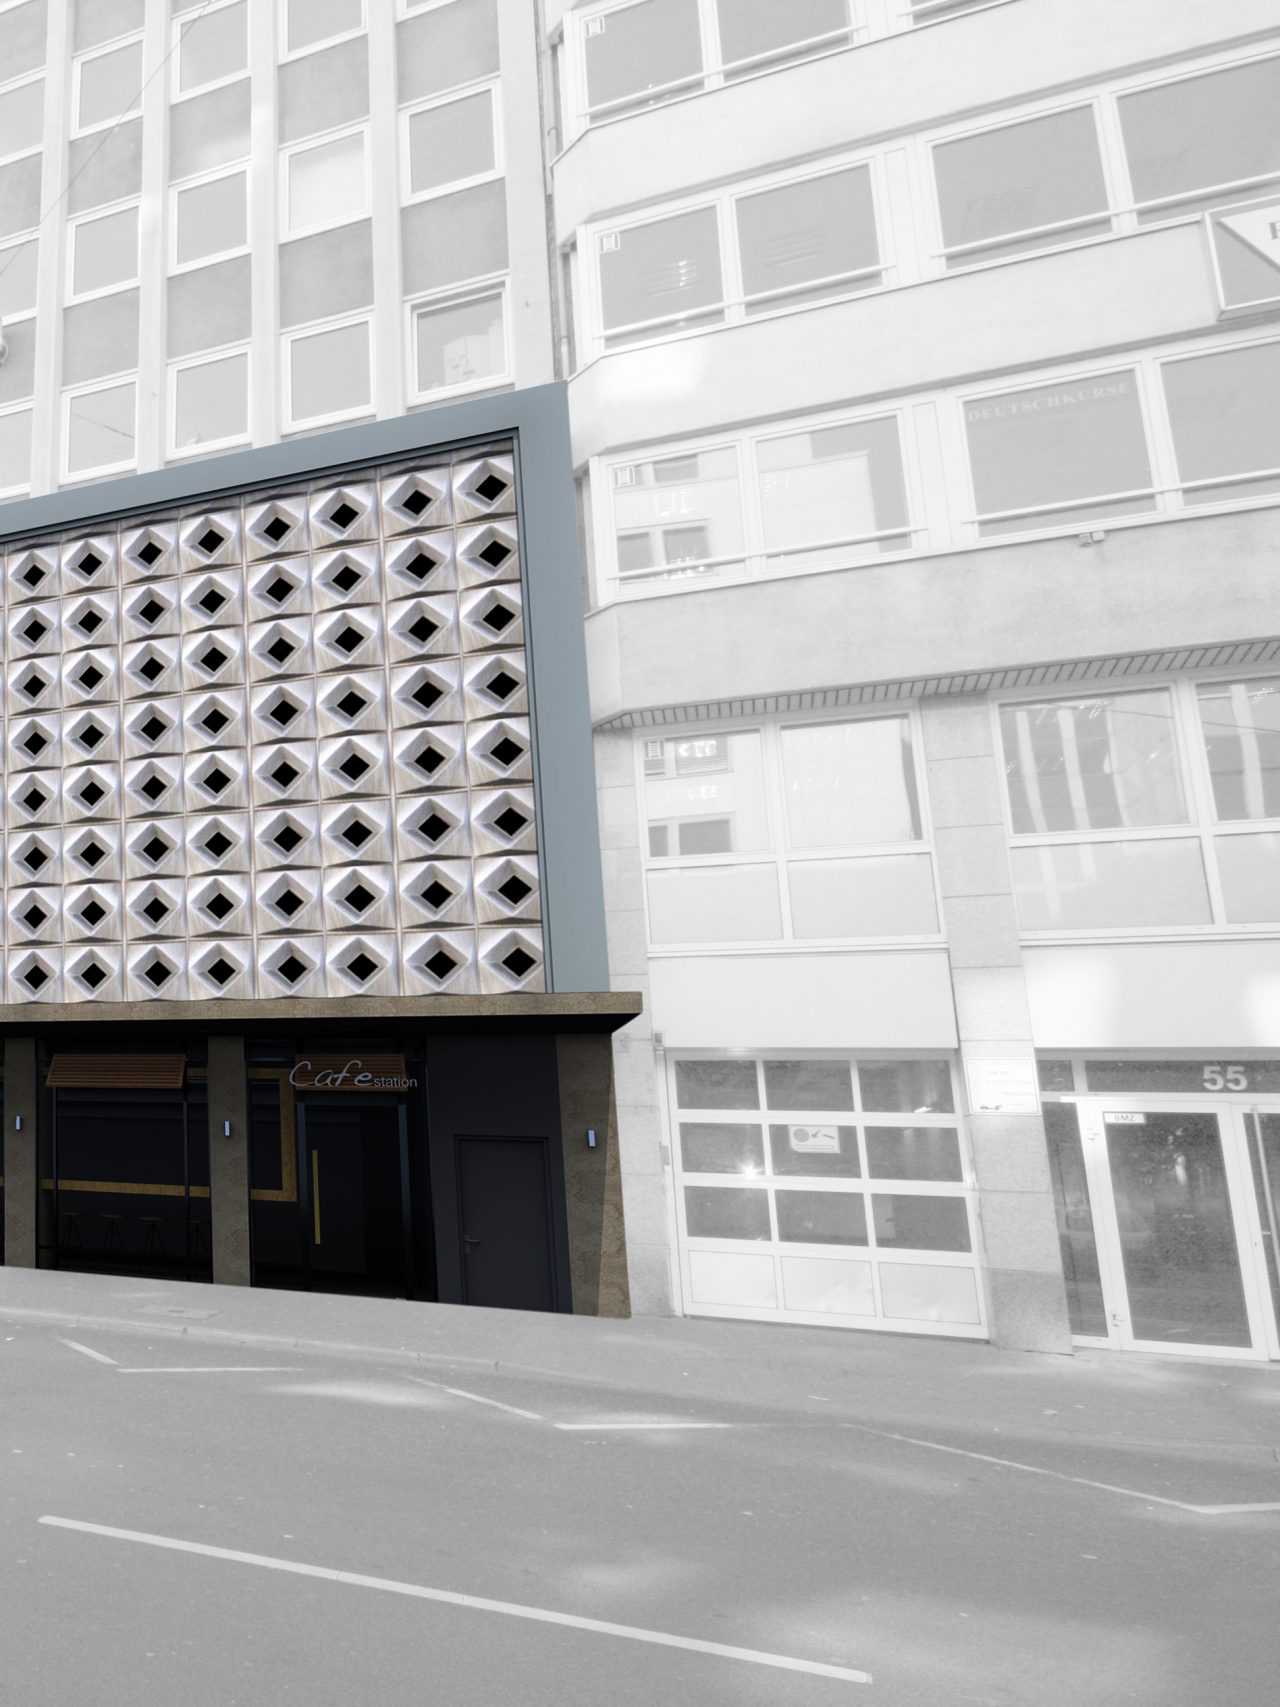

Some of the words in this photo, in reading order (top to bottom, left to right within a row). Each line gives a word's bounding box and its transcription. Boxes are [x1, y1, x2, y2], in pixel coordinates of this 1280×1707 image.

[968, 381, 1131, 422] DEUTSCHKURSE
[288, 1059, 374, 1088] Cafe
[374, 1076, 418, 1088] station
[1203, 1066, 1247, 1091] 55
